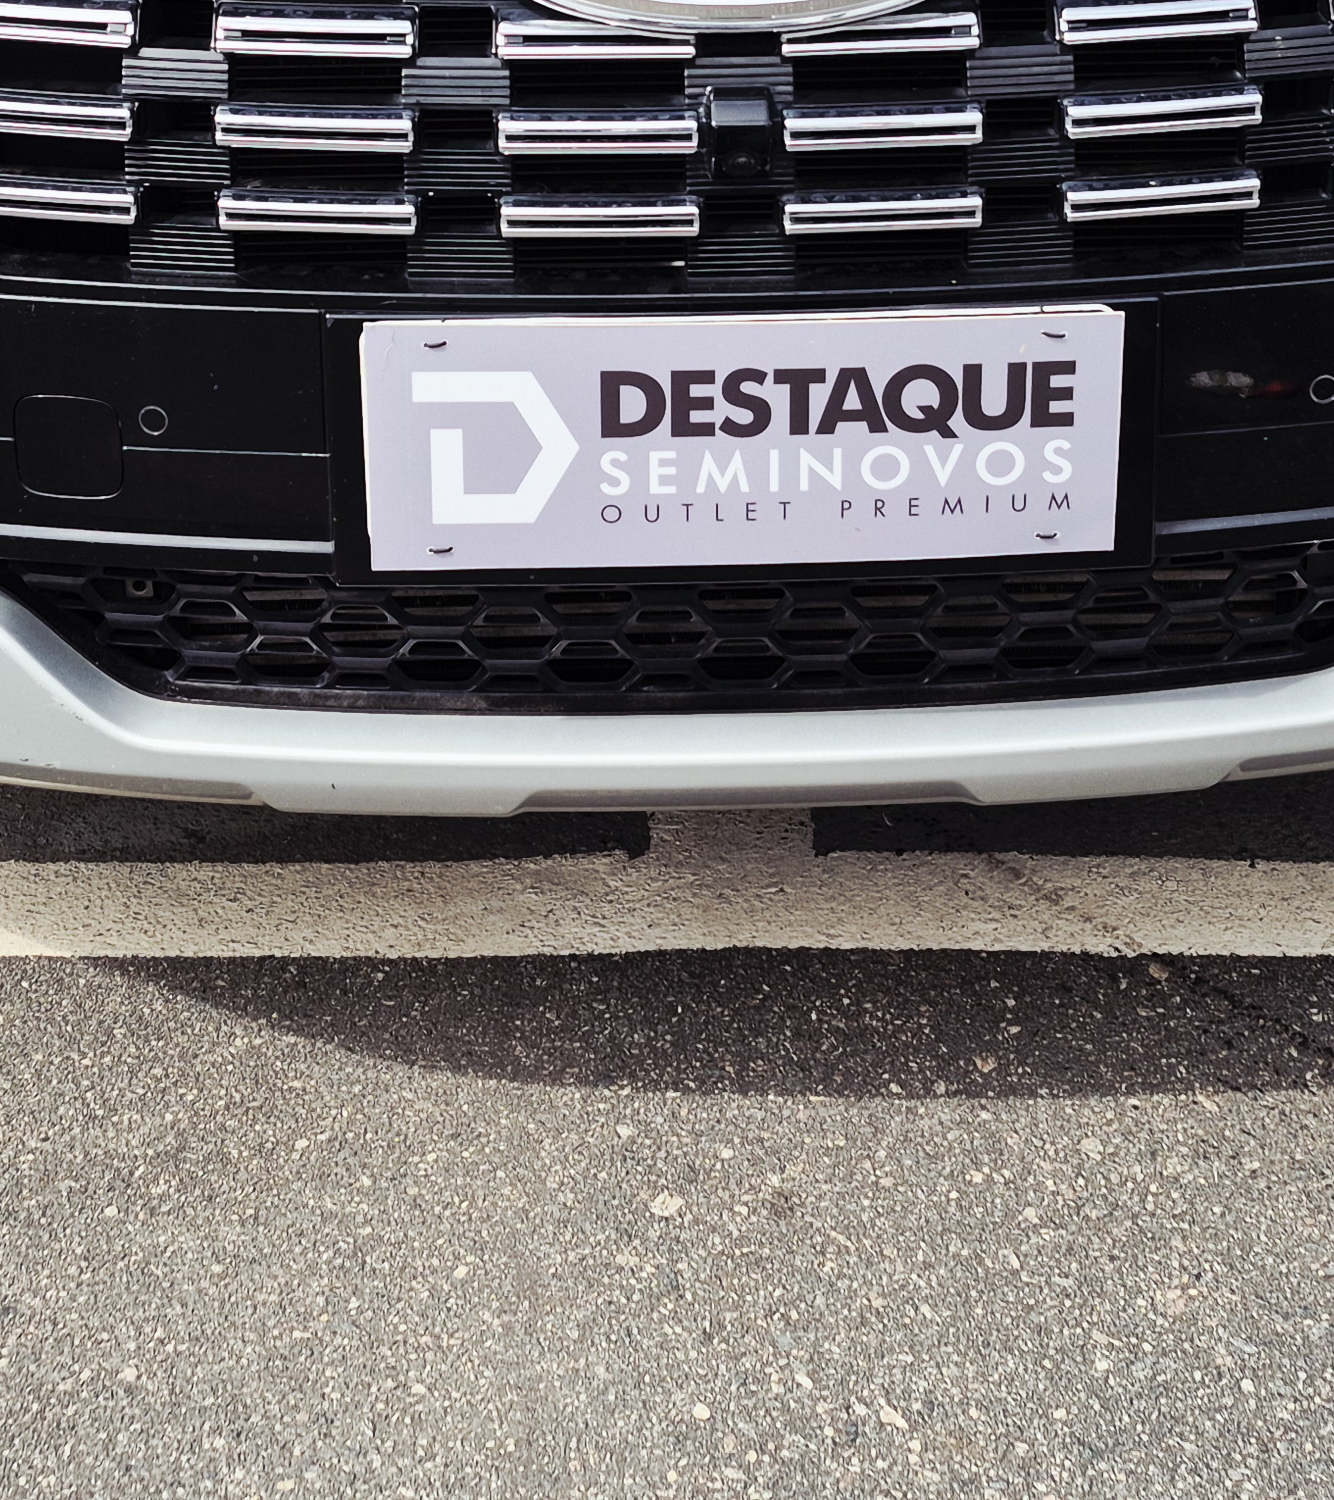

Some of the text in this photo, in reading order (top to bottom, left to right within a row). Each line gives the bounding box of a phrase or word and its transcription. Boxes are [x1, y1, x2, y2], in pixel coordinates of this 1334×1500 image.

[600, 360, 1077, 439] DESTAQUE
[600, 438, 1073, 496] SEMINOVOS
[601, 492, 1072, 524] OUTLET PREMIUM
